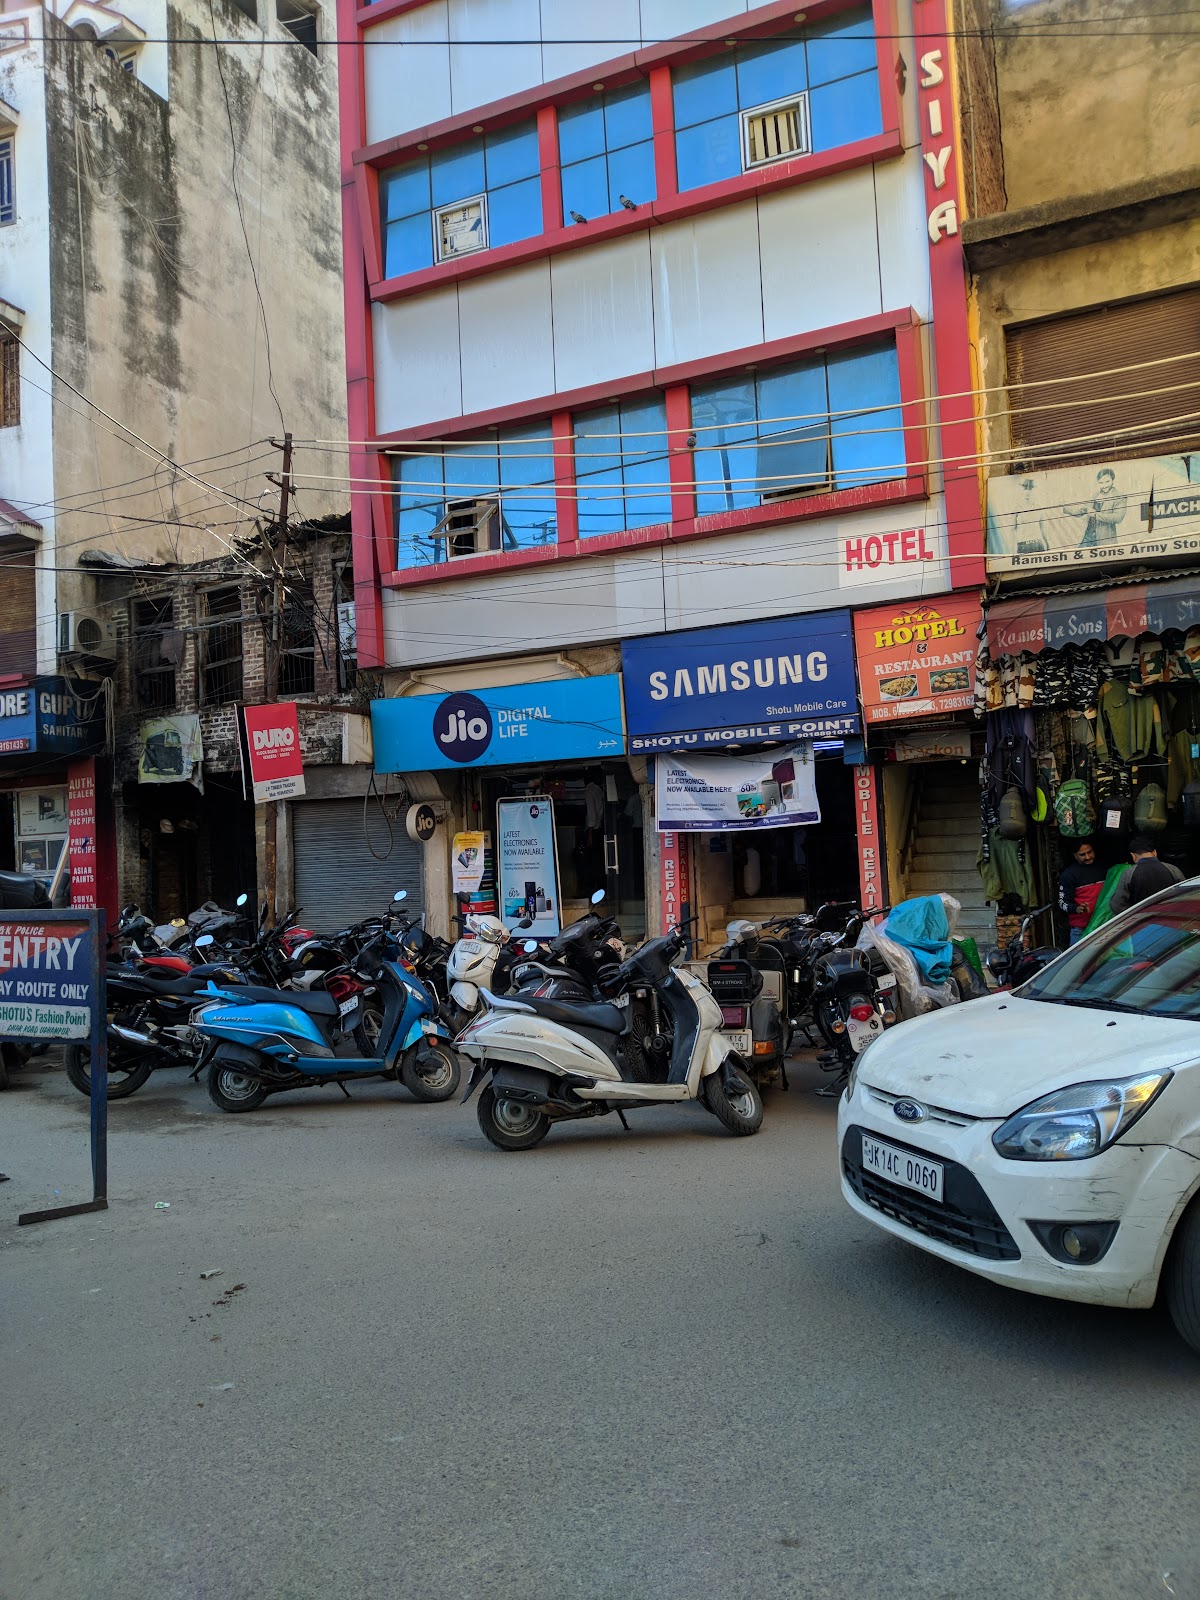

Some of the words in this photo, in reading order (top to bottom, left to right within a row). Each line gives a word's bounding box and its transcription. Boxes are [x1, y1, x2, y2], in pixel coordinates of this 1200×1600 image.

[920, 49, 958, 243] SIYA
[845, 529, 934, 571] HOTEL
[1011, 552, 1068, 566] Ramesh
[1073, 550, 1084, 560] &
[1090, 547, 1125, 559] Sons
[1130, 542, 1168, 555] Army
[892, 611, 941, 626] SIYA
[874, 618, 966, 648] HOTEL
[996, 619, 1052, 648] Ramesh
[1068, 614, 1103, 637] Sons
[916, 643, 928, 654] &
[874, 650, 974, 676] RESTAURANT
[650, 651, 828, 700] SAMSUNG
[497, 706, 552, 723] DIGITAL
[766, 705, 792, 716] Shotu
[794, 702, 824, 713] Mobile
[826, 700, 847, 709] Care
[872, 706, 891, 718] MOB.
[440, 710, 488, 743] Jio
[498, 724, 528, 739] LIFE
[632, 733, 698, 749] SHOTU
[704, 726, 782, 742] MOBILE
[788, 718, 855, 734] POINT
[252, 727, 294, 750] DURO
[666, 769, 688, 778] LATEST
[70, 777, 94, 790] AUTH.
[68, 790, 94, 800] DEALER
[856, 766, 873, 835] MOBILE
[70, 808, 92, 818] KISSAN
[530, 807, 540, 815] Jio
[82, 816, 96, 824] PIPE
[416, 813, 434, 832] Jio
[504, 830, 520, 839] LATEST
[504, 838, 538, 847] ELECTRONICS
[504, 848, 517, 857] NOW
[517, 848, 545, 856] AVAILABLE
[74, 866, 92, 876] ASIAN
[72, 876, 94, 884] PAINTS
[72, 894, 94, 904] SURYA
[664, 860, 676, 931] REPAIR
[14, 926, 45, 936] POLICE
[0, 936, 82, 970] ENTRY
[16, 982, 56, 998] ROUTE
[60, 984, 90, 1000] ONLY
[35, 1009, 66, 1024] Fashion
[65, 1011, 86, 1026] Point
[897, 1102, 914, 1117] Ford
[906, 1160, 937, 1192] 0060
